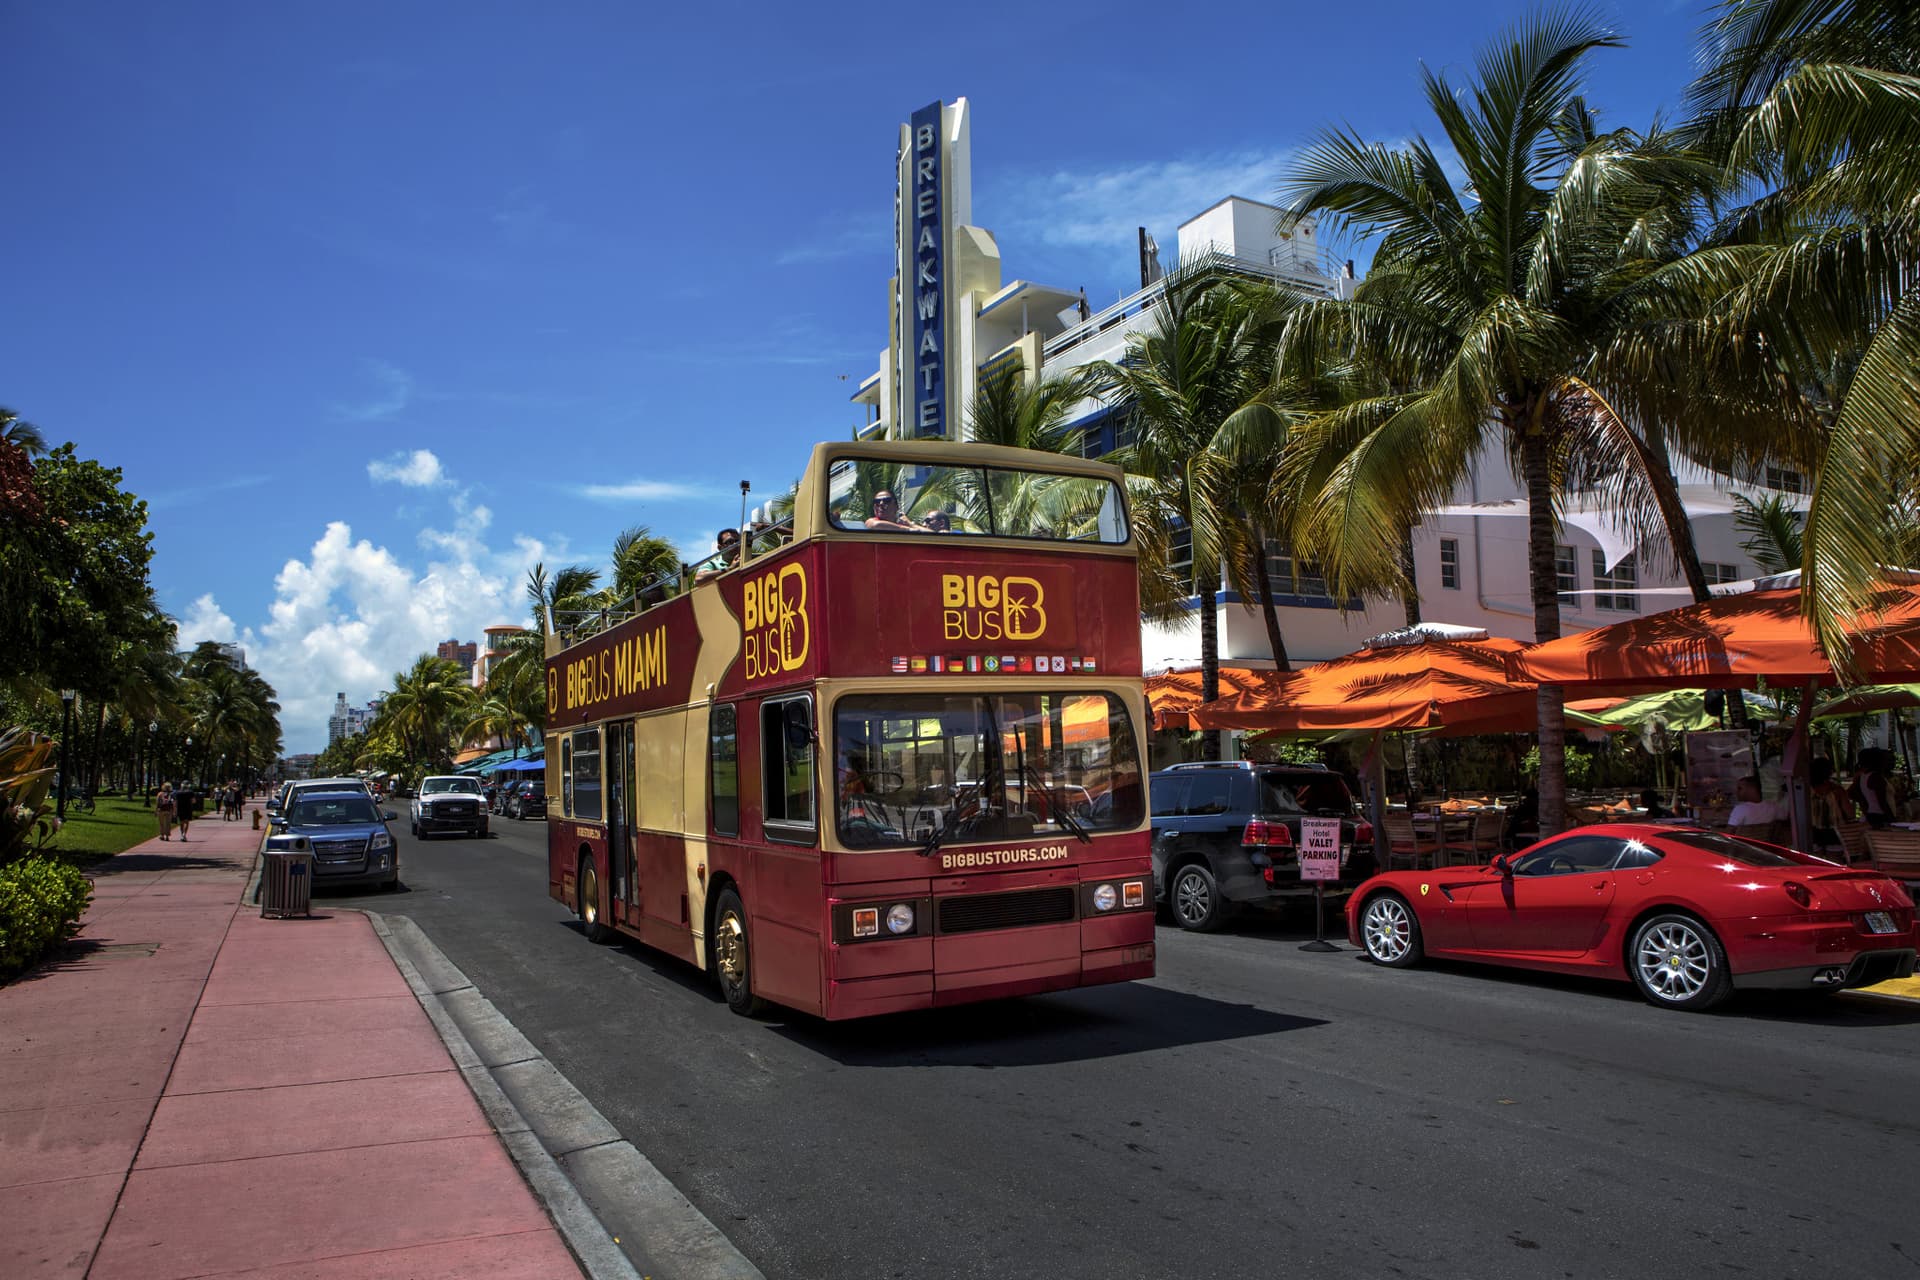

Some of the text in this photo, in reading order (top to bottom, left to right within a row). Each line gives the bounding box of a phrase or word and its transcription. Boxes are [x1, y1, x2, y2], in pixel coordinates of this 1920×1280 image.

[916, 123, 939, 427] BREAKWATE
[744, 572, 778, 631] BIG
[942, 574, 1000, 608] BIG
[944, 610, 1002, 640] BUS
[615, 624, 667, 697] MIAMI
[745, 628, 780, 680] BUS
[942, 846, 1068, 868] BIGBUSTOURS.COM
[1302, 851, 1338, 860] PARKING
[1309, 838, 1333, 848] VALET
